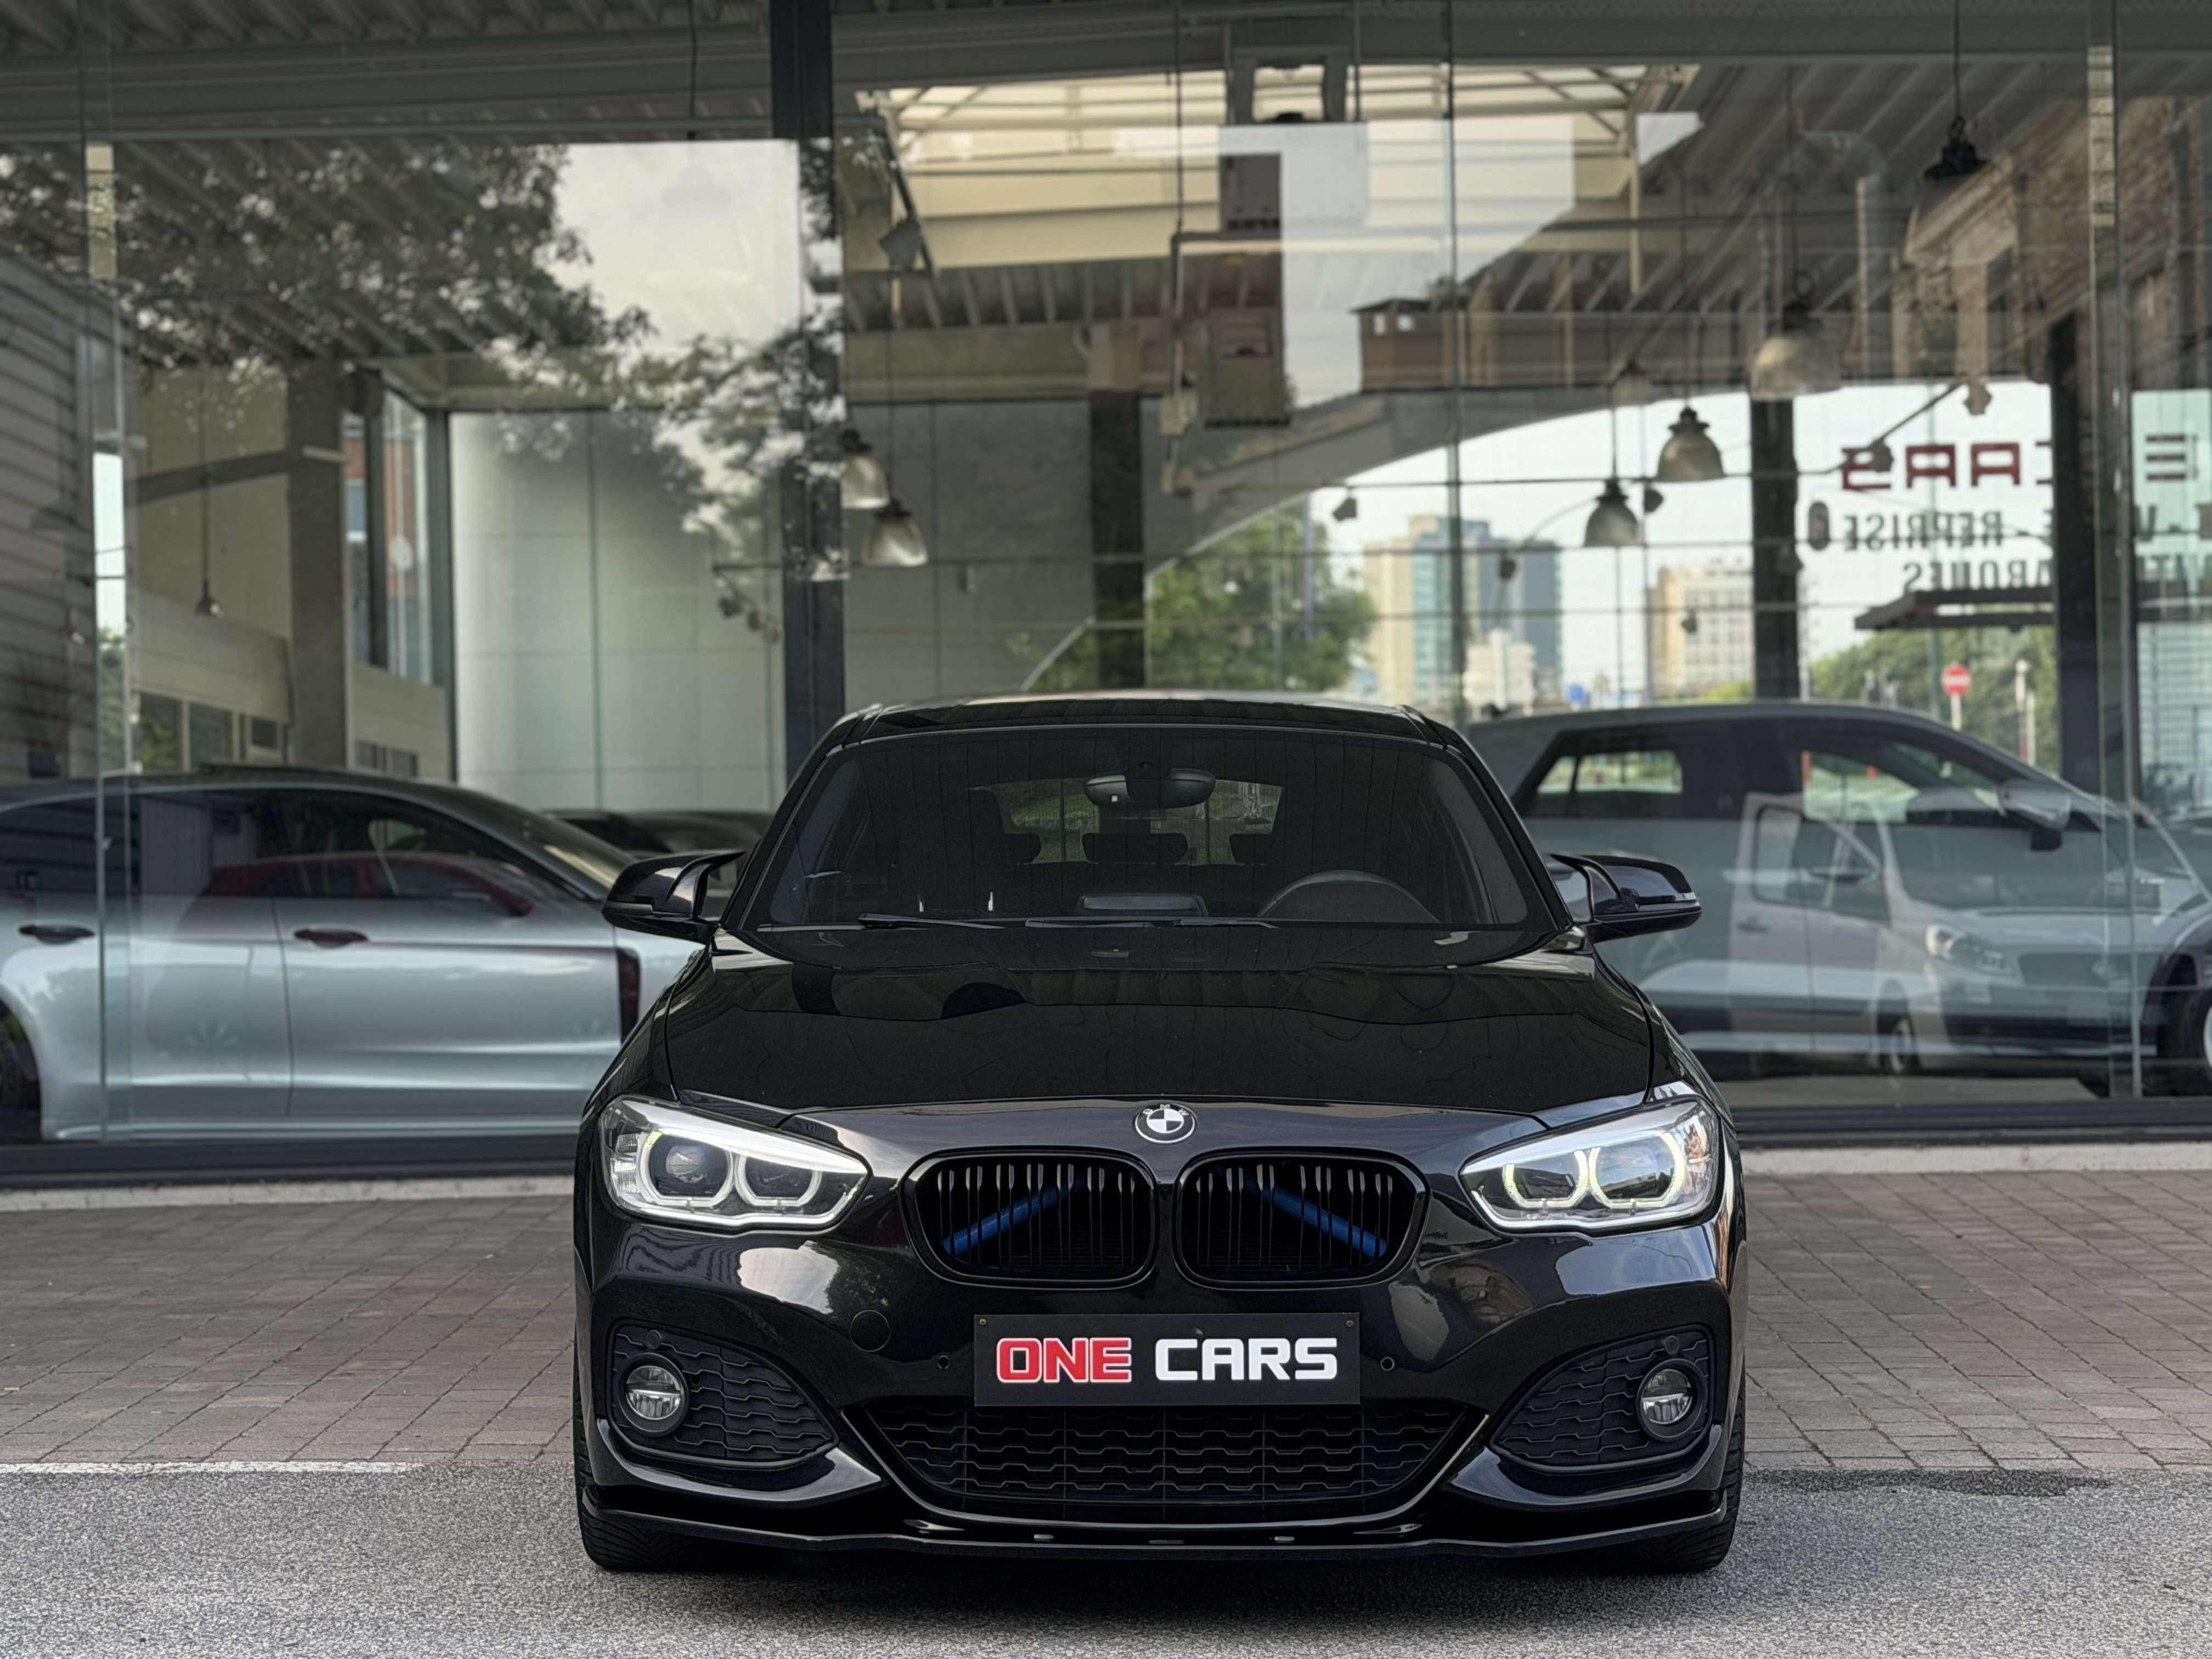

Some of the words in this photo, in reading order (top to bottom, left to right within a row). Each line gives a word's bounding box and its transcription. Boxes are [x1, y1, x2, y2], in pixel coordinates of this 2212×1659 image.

[1142, 1103, 1189, 1116] BMW
[996, 1338, 1132, 1383] ONE
[1155, 1338, 1338, 1381] CARS
